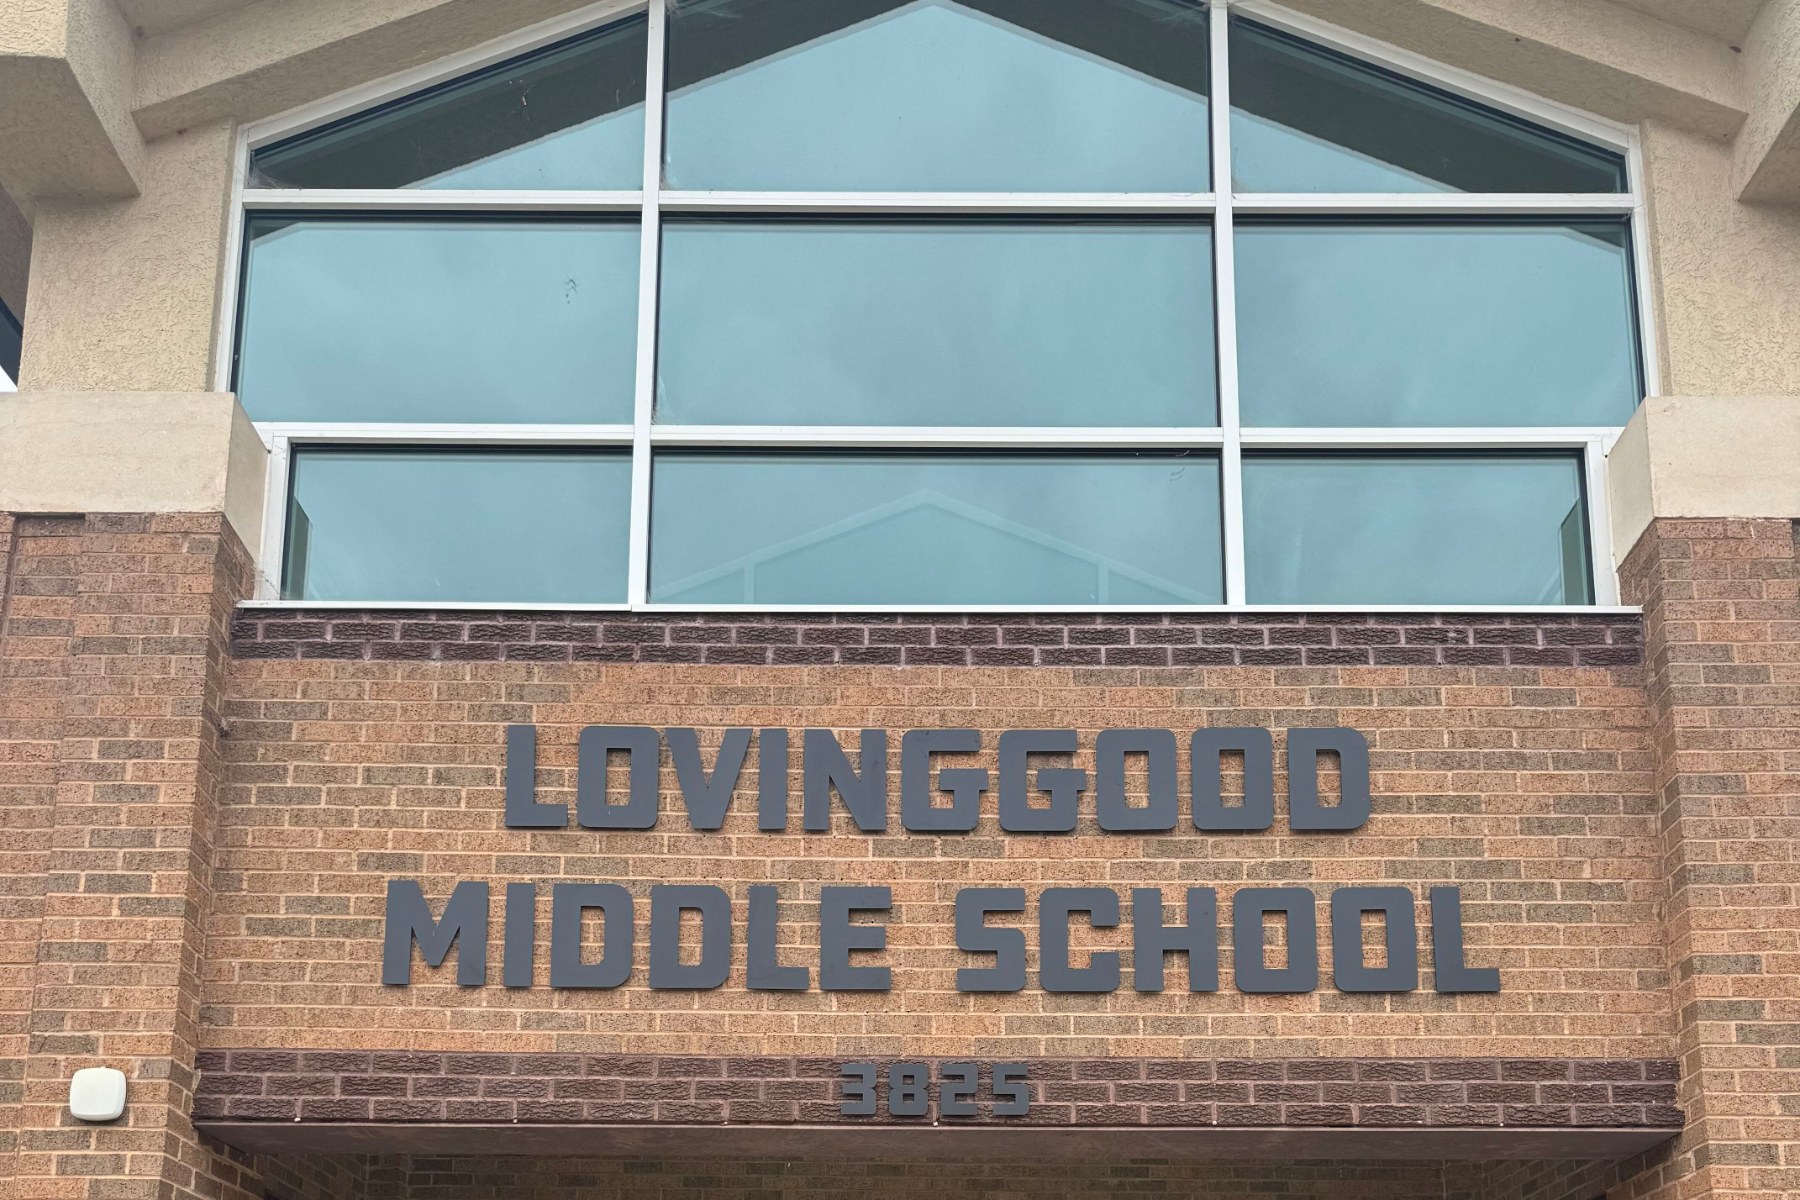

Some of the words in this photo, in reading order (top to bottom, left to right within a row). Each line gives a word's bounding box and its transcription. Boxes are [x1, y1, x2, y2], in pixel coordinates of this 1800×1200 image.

[505, 724, 1371, 833] LOVINGGOOD
[383, 880, 892, 992] MIDDLE
[957, 886, 1501, 994] SCHOOL
[839, 1062, 1031, 1118] 3825
